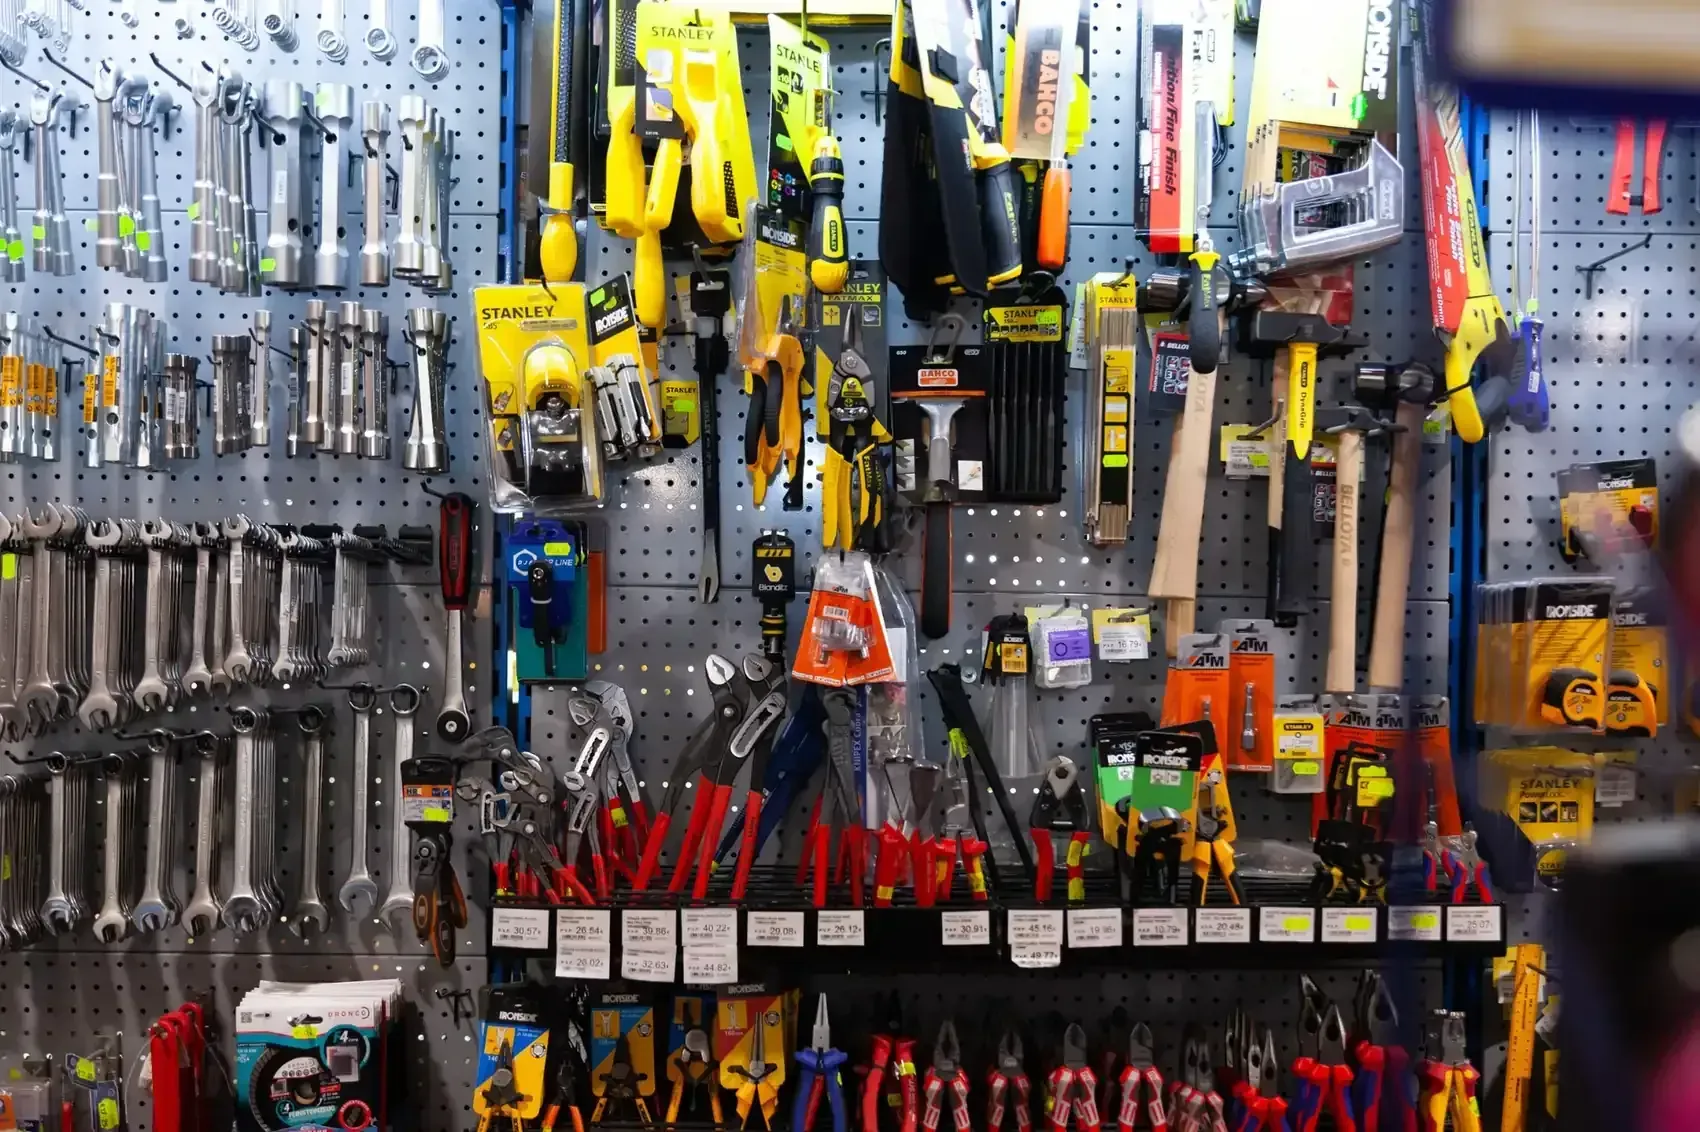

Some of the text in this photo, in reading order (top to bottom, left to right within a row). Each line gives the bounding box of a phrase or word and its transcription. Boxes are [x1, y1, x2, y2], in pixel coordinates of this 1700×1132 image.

[652, 26, 714, 40] STANLEY
[776, 44, 820, 72] STANLE
[1034, 50, 1060, 134] BAHCO
[1164, 146, 1177, 195] Finish
[762, 226, 799, 245] IRONSIDE
[830, 221, 838, 251] STANLEY
[841, 283, 880, 293] ANLEY
[1100, 296, 1134, 304] STANLEY
[482, 305, 555, 320] STANLEY
[595, 305, 630, 332] IRONSIDE
[666, 386, 697, 394] STANLEY
[1299, 392, 1307, 429] DynaGrip
[1340, 484, 1353, 553] BELLOTA
[1546, 604, 1598, 618] IRONSIDE
[1236, 637, 1268, 652] ATM
[1192, 652, 1224, 667] ATM
[1340, 711, 1371, 727] ATM
[1107, 753, 1136, 766] IRONS
[1143, 754, 1189, 768] IRONSIDE
[1520, 778, 1581, 789] STANLEY
[728, 984, 766, 994] IRONSIDE
[602, 994, 639, 1003] IRONSIDE
[328, 1007, 367, 1018] DRONCO
[499, 1010, 539, 1023] IRONSIDE
